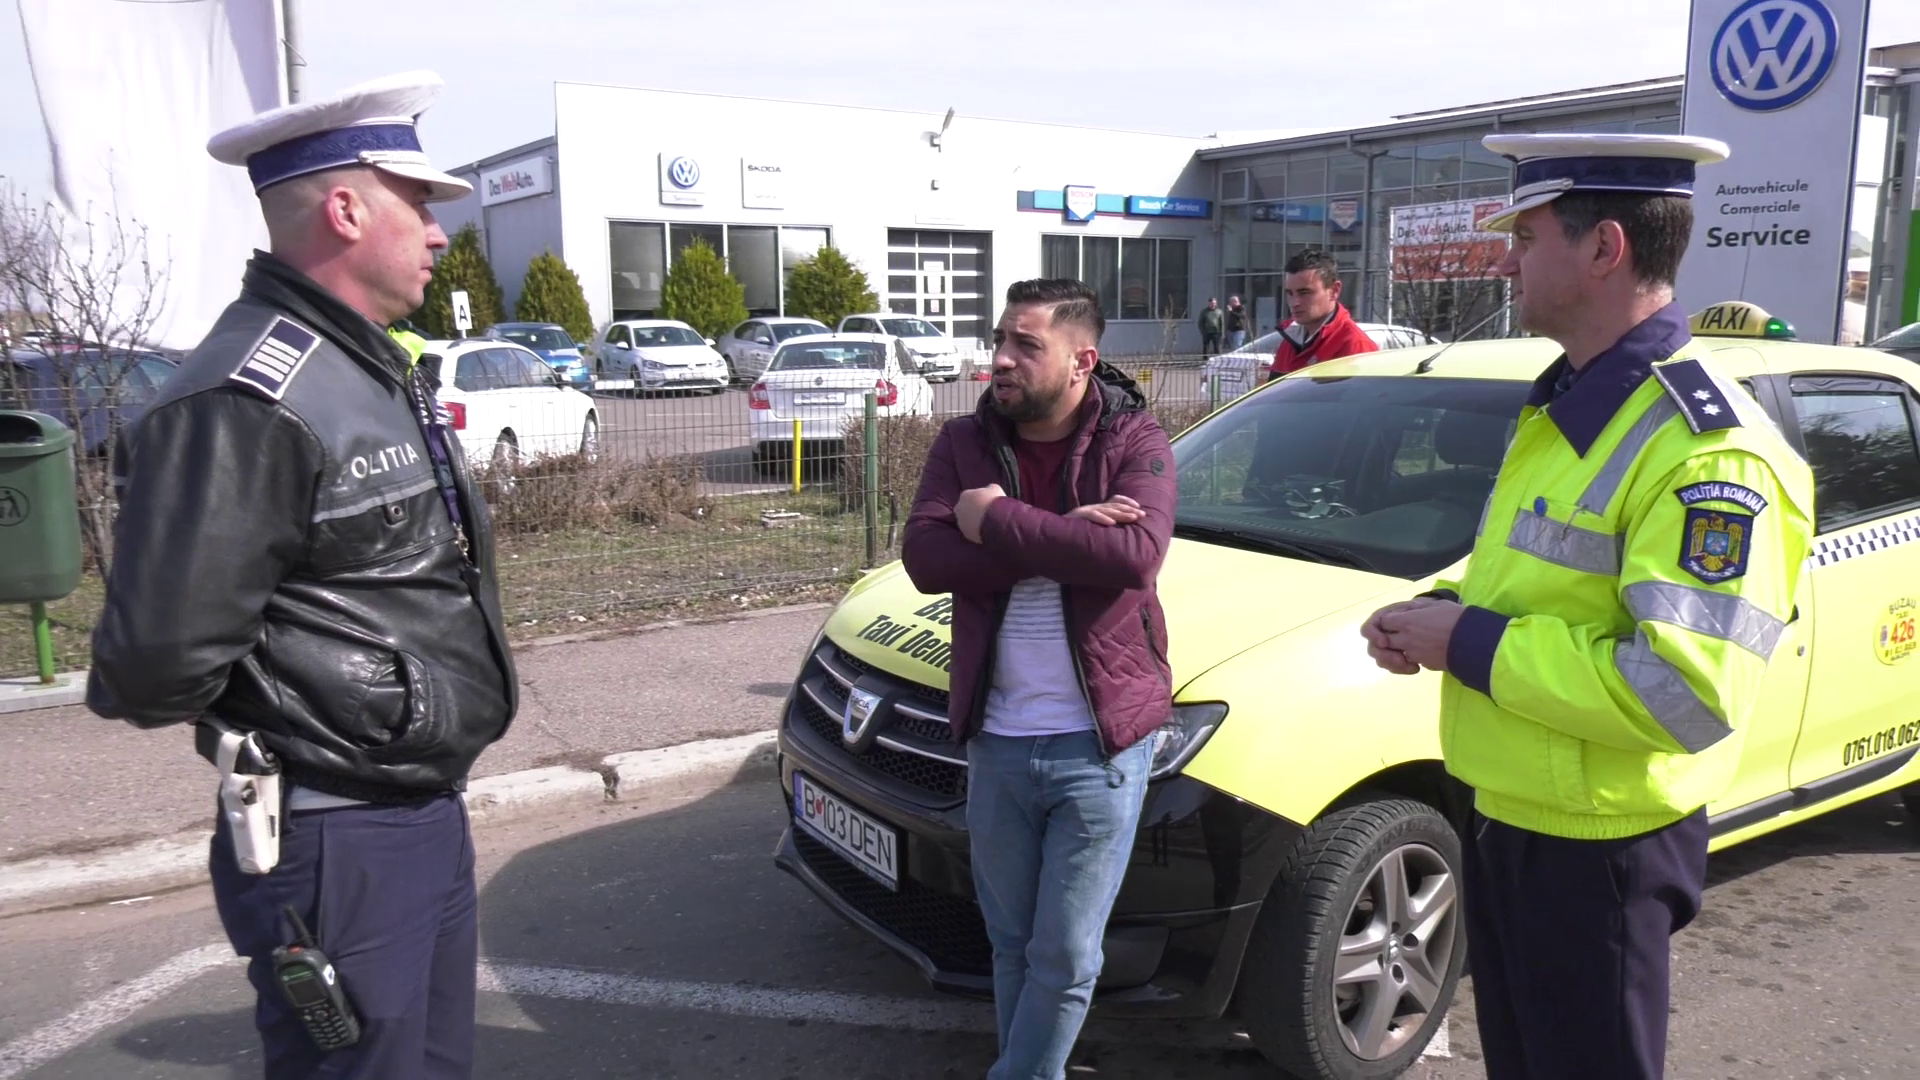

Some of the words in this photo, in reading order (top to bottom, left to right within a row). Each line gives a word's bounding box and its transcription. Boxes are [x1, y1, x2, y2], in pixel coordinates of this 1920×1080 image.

[1070, 190, 1094, 199] BOSCH
[1715, 179, 1809, 196] Autovehicule
[1138, 200, 1161, 210] Bosch
[1161, 202, 1174, 211] Car
[1174, 203, 1200, 212] Service
[1720, 200, 1801, 215] Comerciale
[1706, 223, 1811, 248] Service
[459, 304, 468, 323] A
[1700, 306, 1751, 330] TAXI
[856, 614, 917, 647] Taxi
[1890, 617, 1915, 645] 426
[1843, 719, 1920, 767] 0761.018.062
